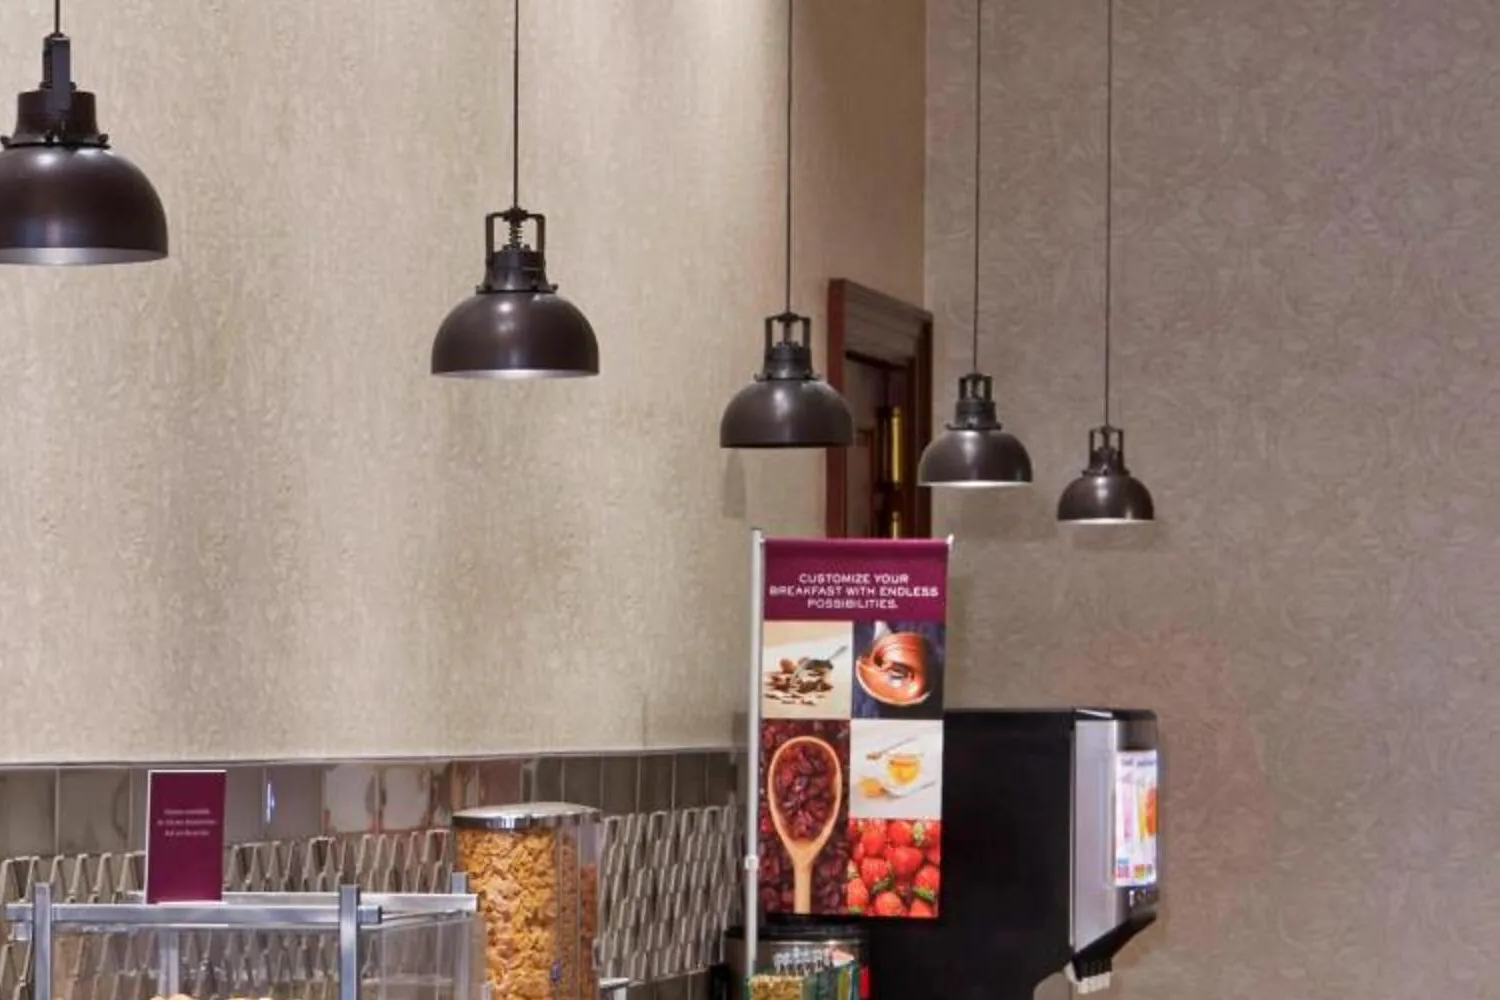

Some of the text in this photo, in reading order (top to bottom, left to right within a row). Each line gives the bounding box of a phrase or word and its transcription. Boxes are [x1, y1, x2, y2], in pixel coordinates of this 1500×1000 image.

[799, 573, 909, 585] CUSTOMIZE YOUR
[769, 586, 939, 598] BREAKFAST WITH ENDLESS
[807, 598, 899, 609] POSSIBILITIES.
